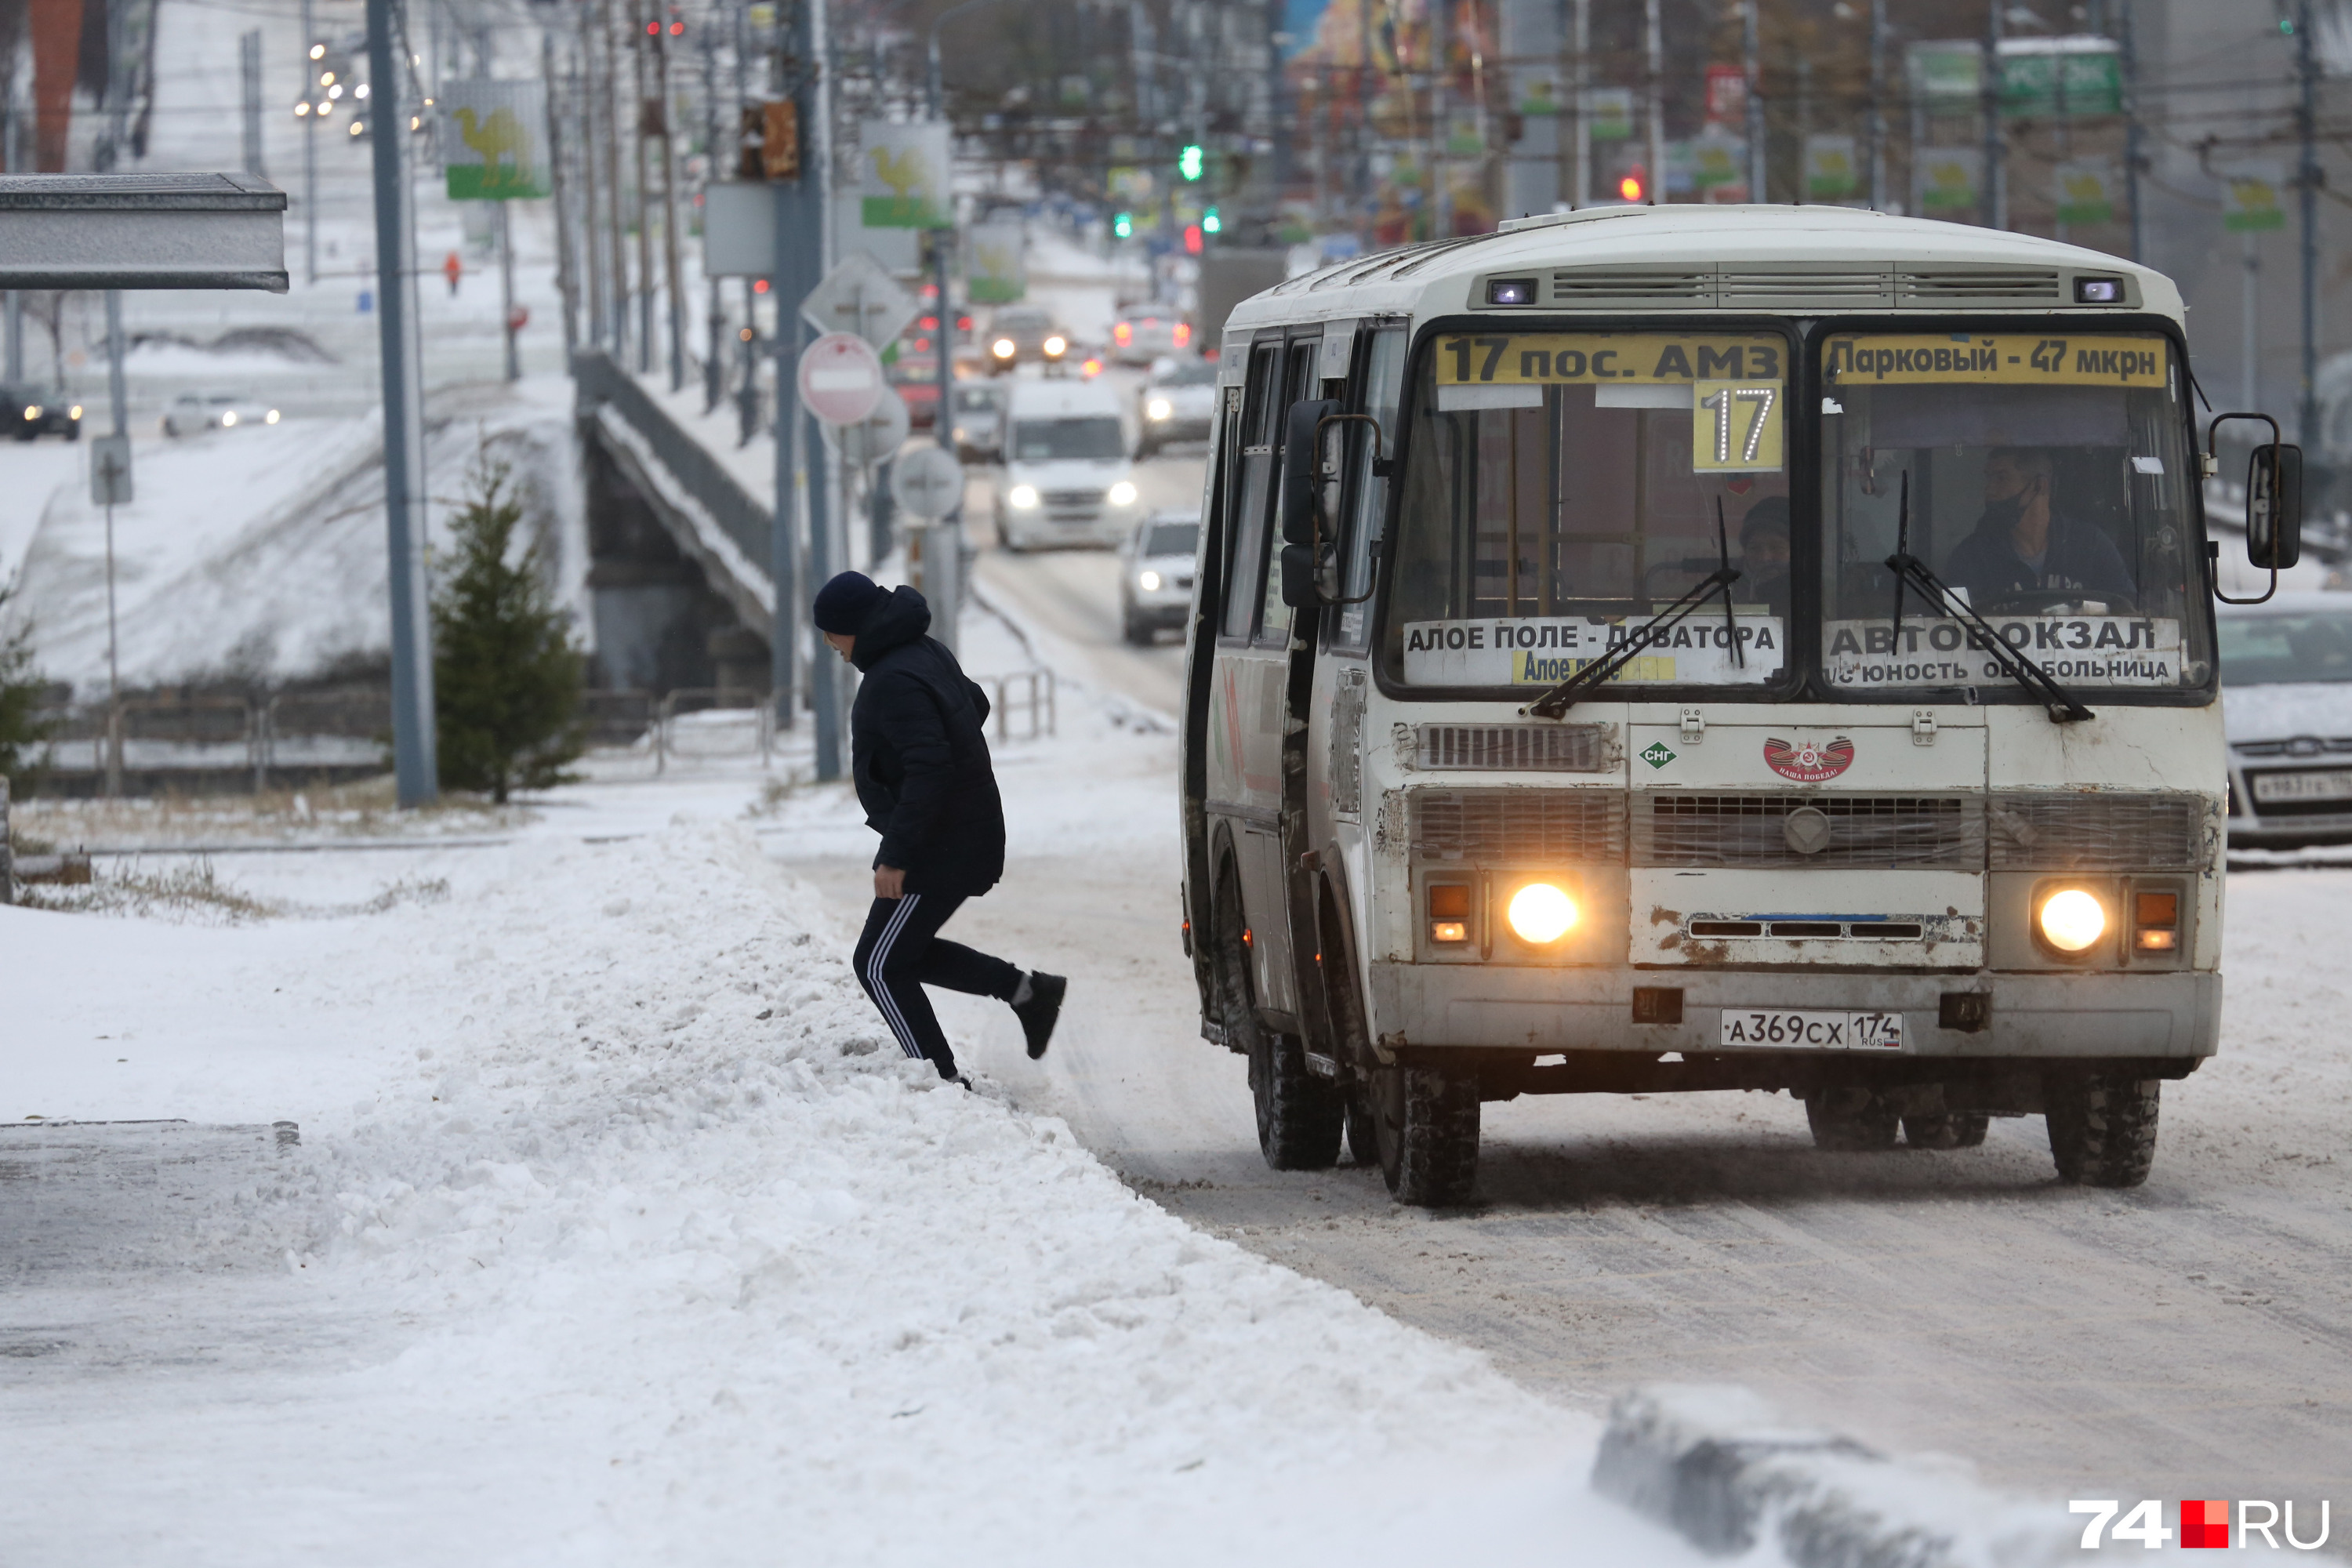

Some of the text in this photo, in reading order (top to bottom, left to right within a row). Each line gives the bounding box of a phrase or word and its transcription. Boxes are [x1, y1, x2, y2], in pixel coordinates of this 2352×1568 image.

[1445, 337, 1779, 382] 17 пос. АМЗ
[1829, 340, 1998, 379] Парковый
[2031, 340, 2068, 372] 47
[2076, 350, 2155, 380] мкрн
[1700, 387, 1777, 463] 17
[1408, 627, 1484, 652] АЛОЕ
[1495, 626, 1578, 648] ПОЛЕ
[1606, 626, 1775, 652] ДОВАТОРА
[1830, 622, 2154, 656] АВТОВОКЗАЛ
[1524, 651, 1570, 681] Алое
[1863, 662, 1969, 682] ЮНОСТЬ
[2042, 661, 2169, 680] БОЛЬНИЦА
[1645, 750, 1671, 761] СНГ
[1779, 768, 1838, 780] НАША ПОБЕДА!
[1854, 1017, 1894, 1039] 174
[1862, 1037, 1883, 1046] RUS
